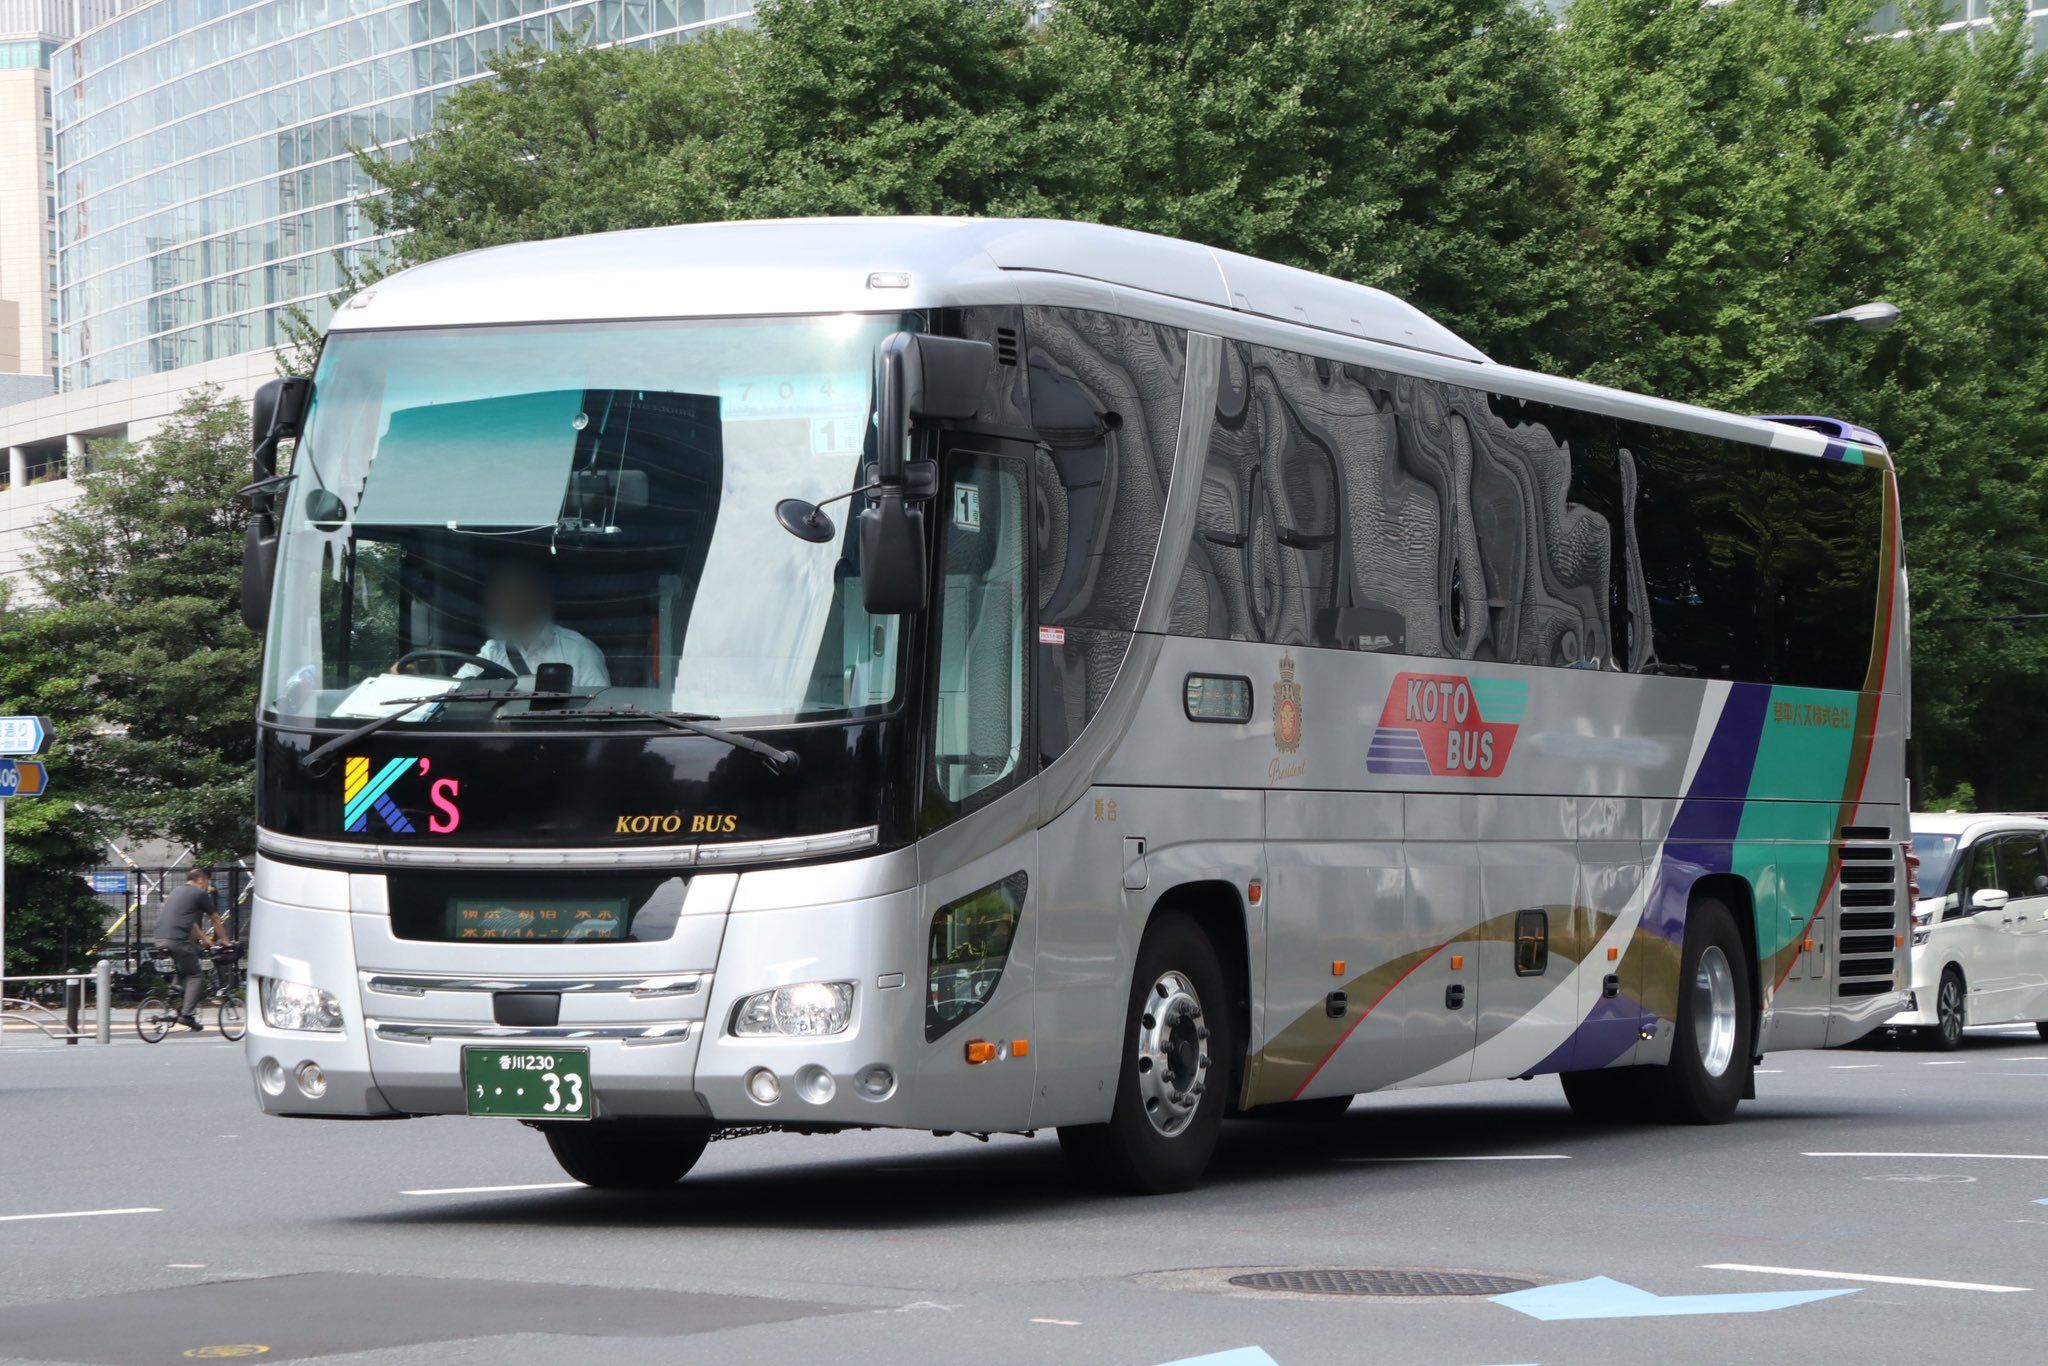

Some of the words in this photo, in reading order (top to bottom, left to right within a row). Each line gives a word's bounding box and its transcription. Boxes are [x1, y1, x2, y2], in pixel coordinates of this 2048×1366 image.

[961, 491, 969, 521] 1
[1405, 678, 1470, 724] KOTO
[0, 722, 28, 737] 通り
[1445, 728, 1494, 771] BUS
[0, 768, 18, 787] 06
[615, 815, 681, 833] KOTO
[690, 815, 738, 832] BUS
[499, 1055, 555, 1070] 香川230
